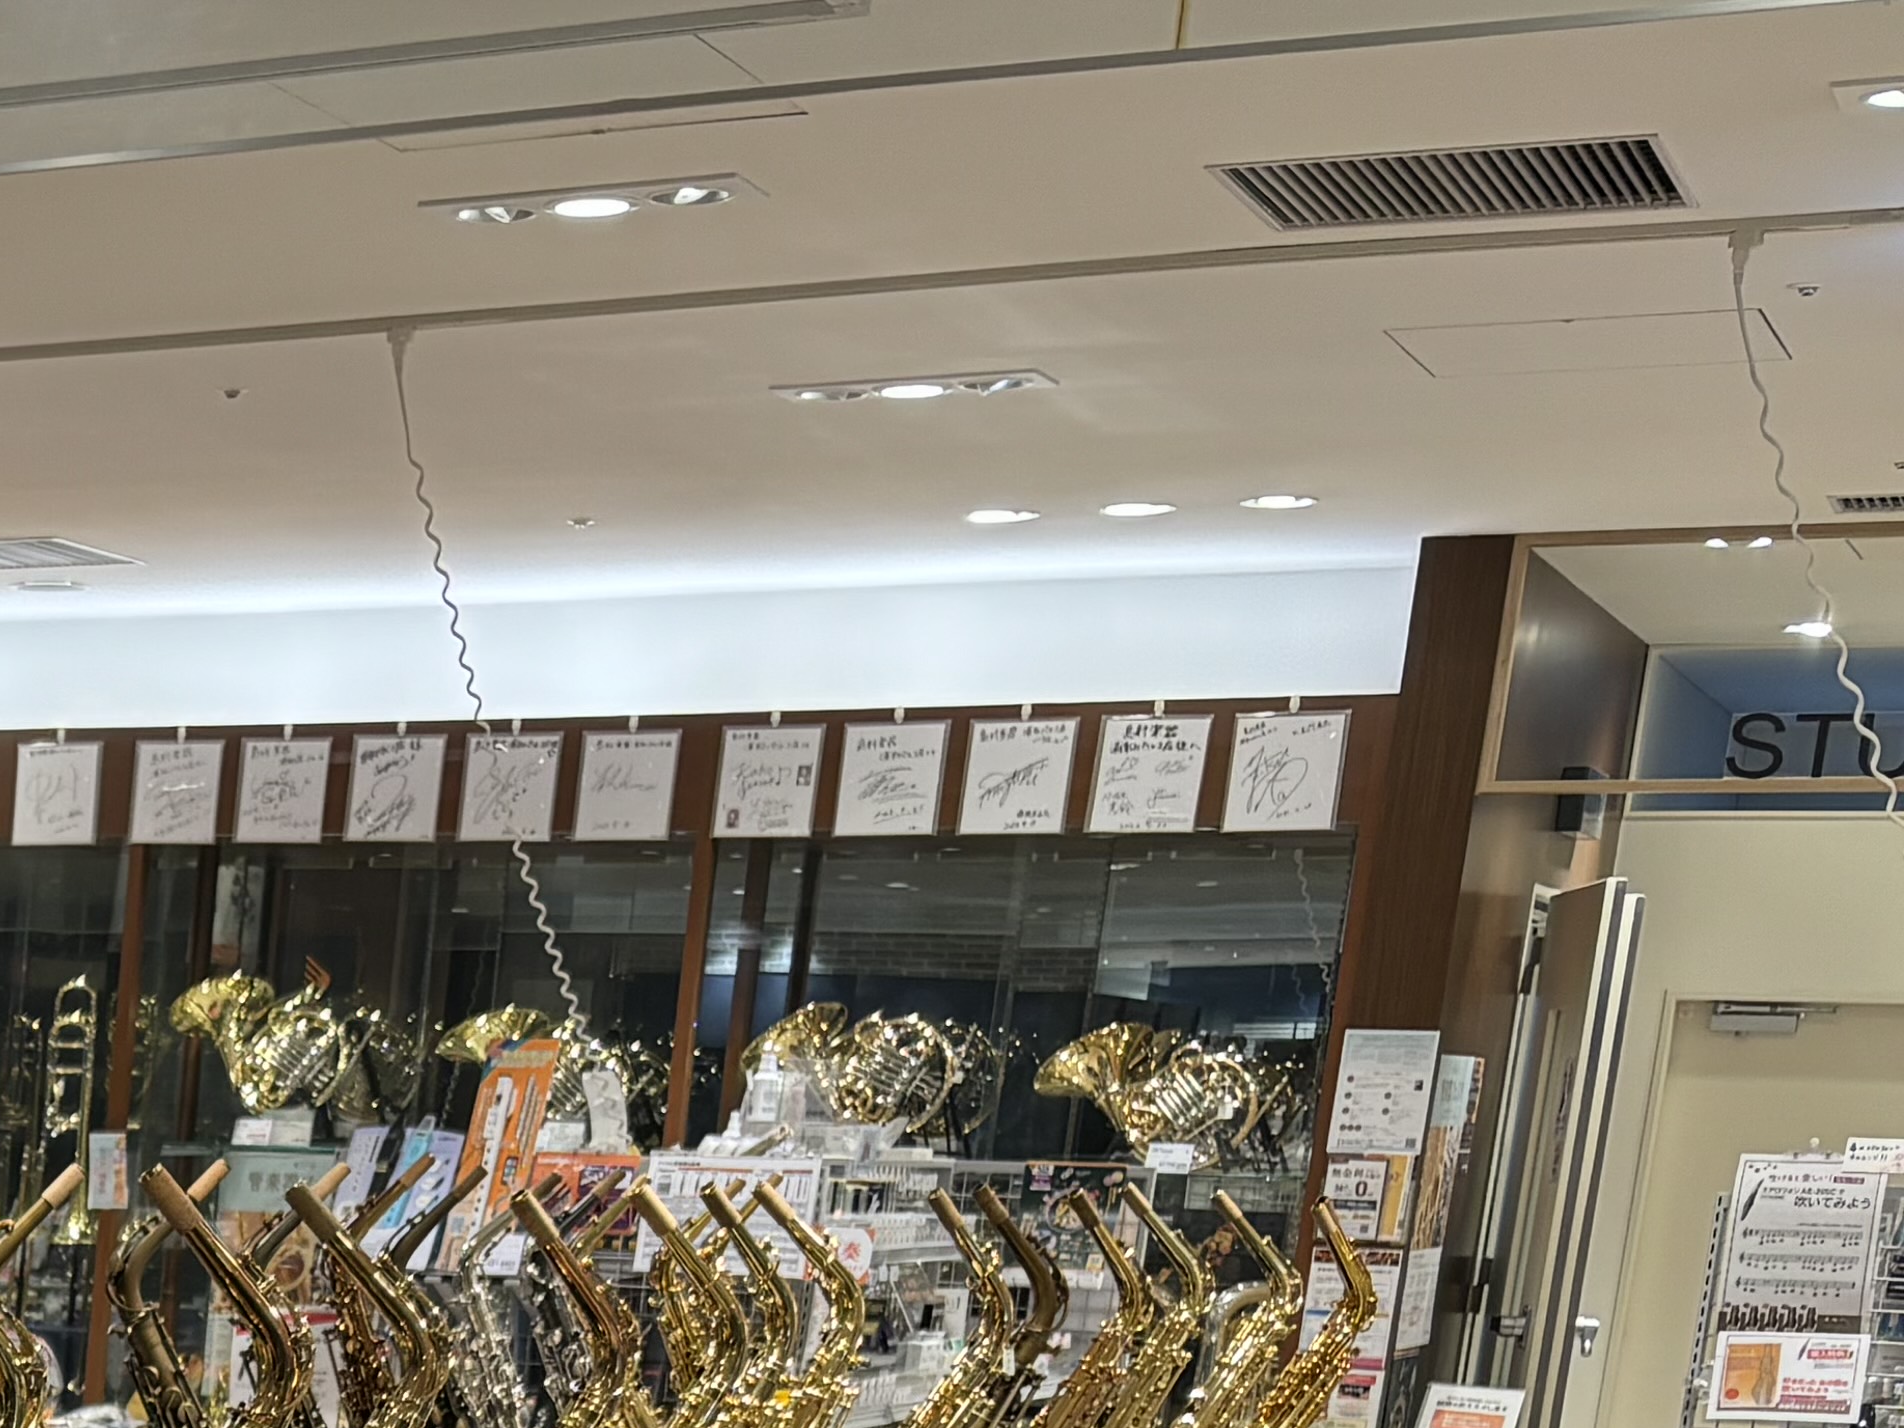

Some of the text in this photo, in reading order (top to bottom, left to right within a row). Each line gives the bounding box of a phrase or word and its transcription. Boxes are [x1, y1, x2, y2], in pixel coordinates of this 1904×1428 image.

[1794, 1196, 1872, 1209] 吹いてみよう
